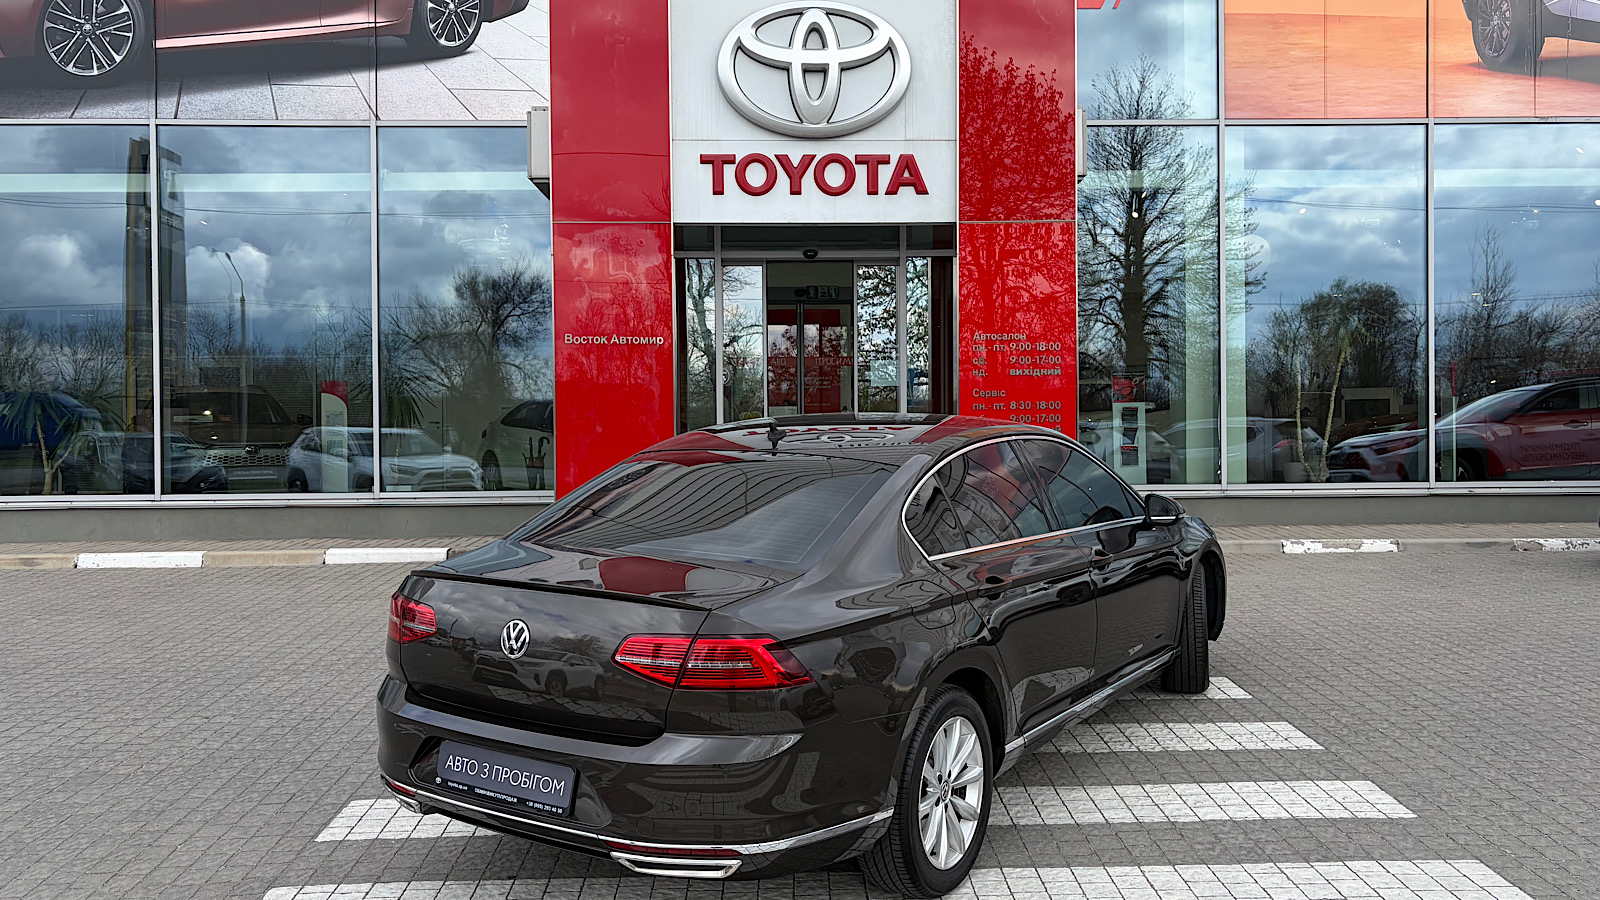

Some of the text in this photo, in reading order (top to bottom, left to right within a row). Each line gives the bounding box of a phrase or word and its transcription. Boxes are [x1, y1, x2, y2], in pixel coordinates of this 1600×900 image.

[699, 152, 930, 197] TOYOTA
[564, 333, 664, 348] Восток Автомир
[972, 332, 1027, 341] Автосалон
[972, 356, 988, 365] сб.
[972, 366, 1061, 377] нд. вихідний
[972, 388, 1007, 399] Сервіс
[445, 754, 479, 776] АВТО
[491, 765, 565, 797] ПРОБІГОМ
